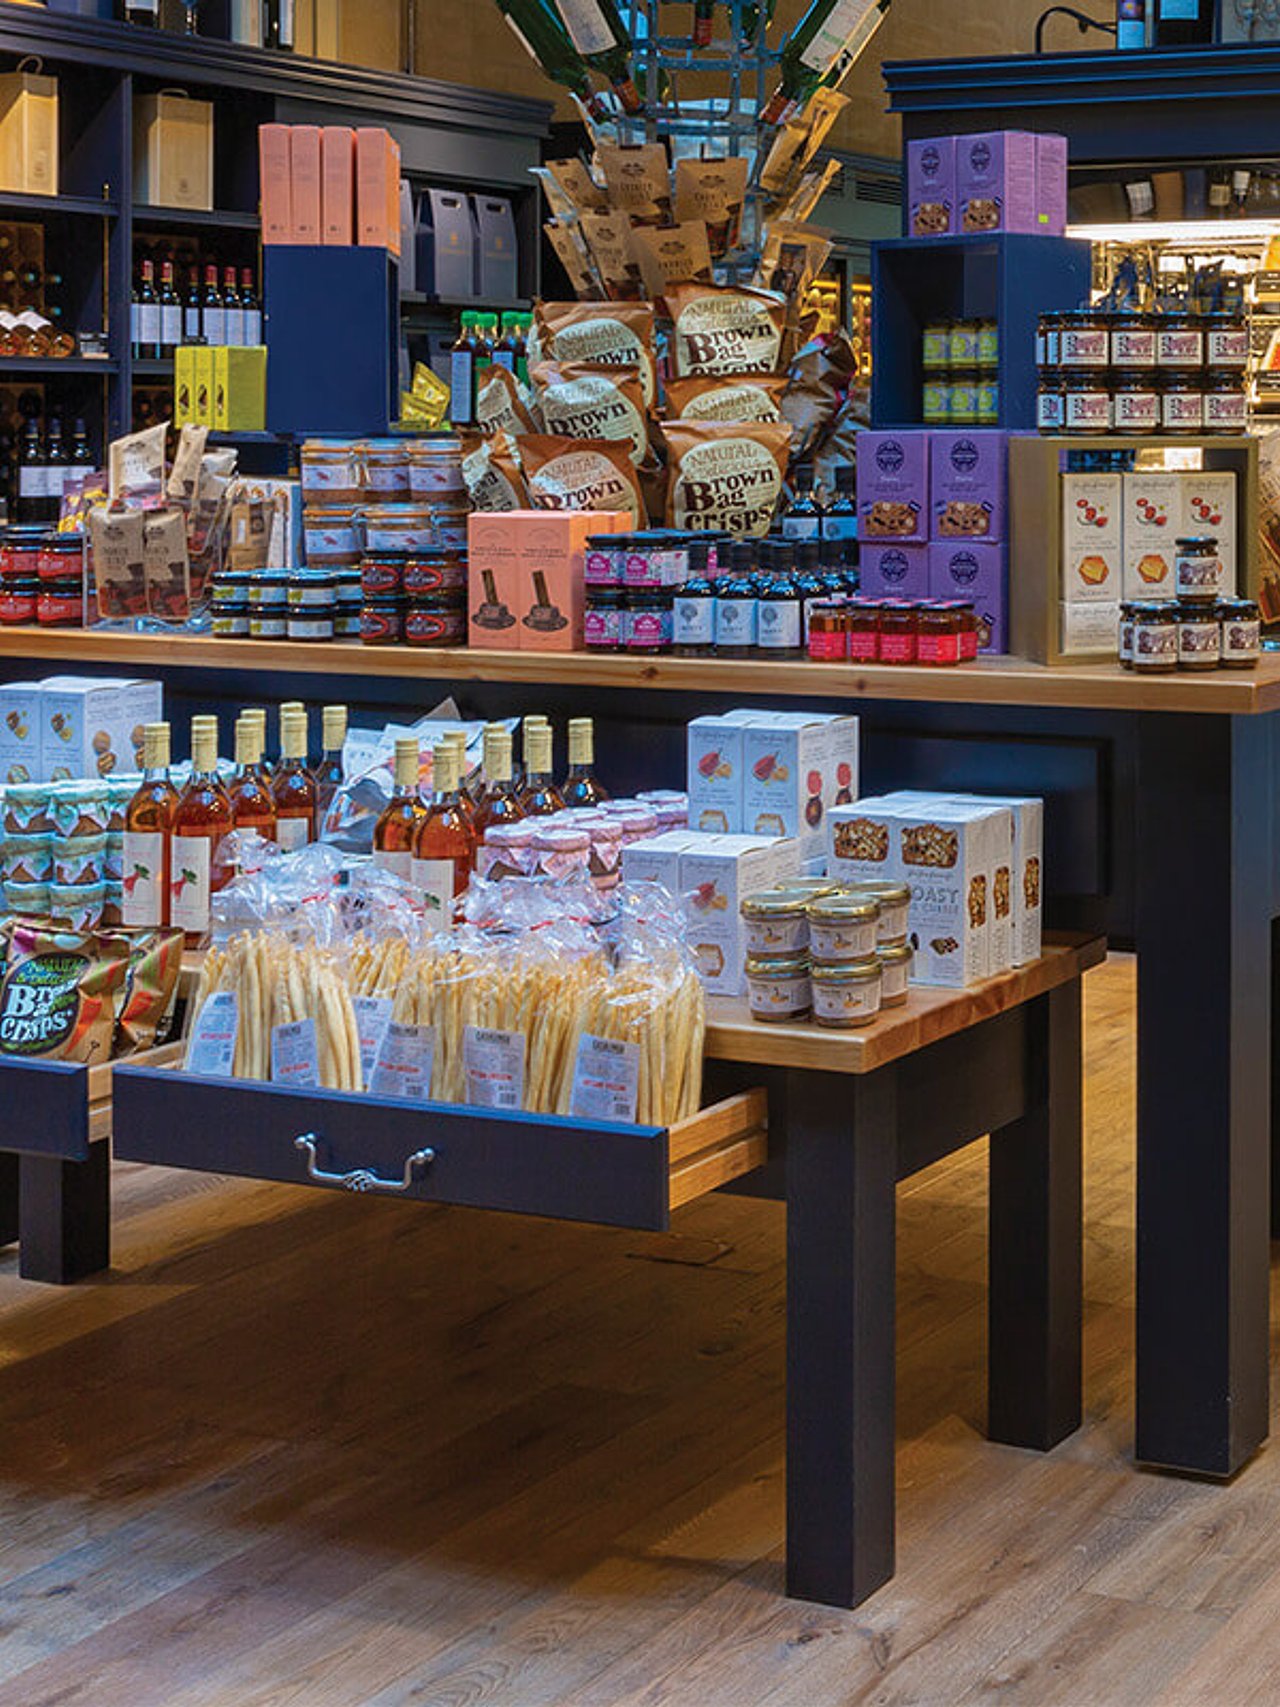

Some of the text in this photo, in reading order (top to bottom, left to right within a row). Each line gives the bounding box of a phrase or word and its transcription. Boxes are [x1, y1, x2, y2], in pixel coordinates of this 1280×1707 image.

[586, 347, 639, 364] own
[681, 324, 772, 366] Brown
[681, 469, 774, 512] Brown
[910, 885, 959, 904] OAST
